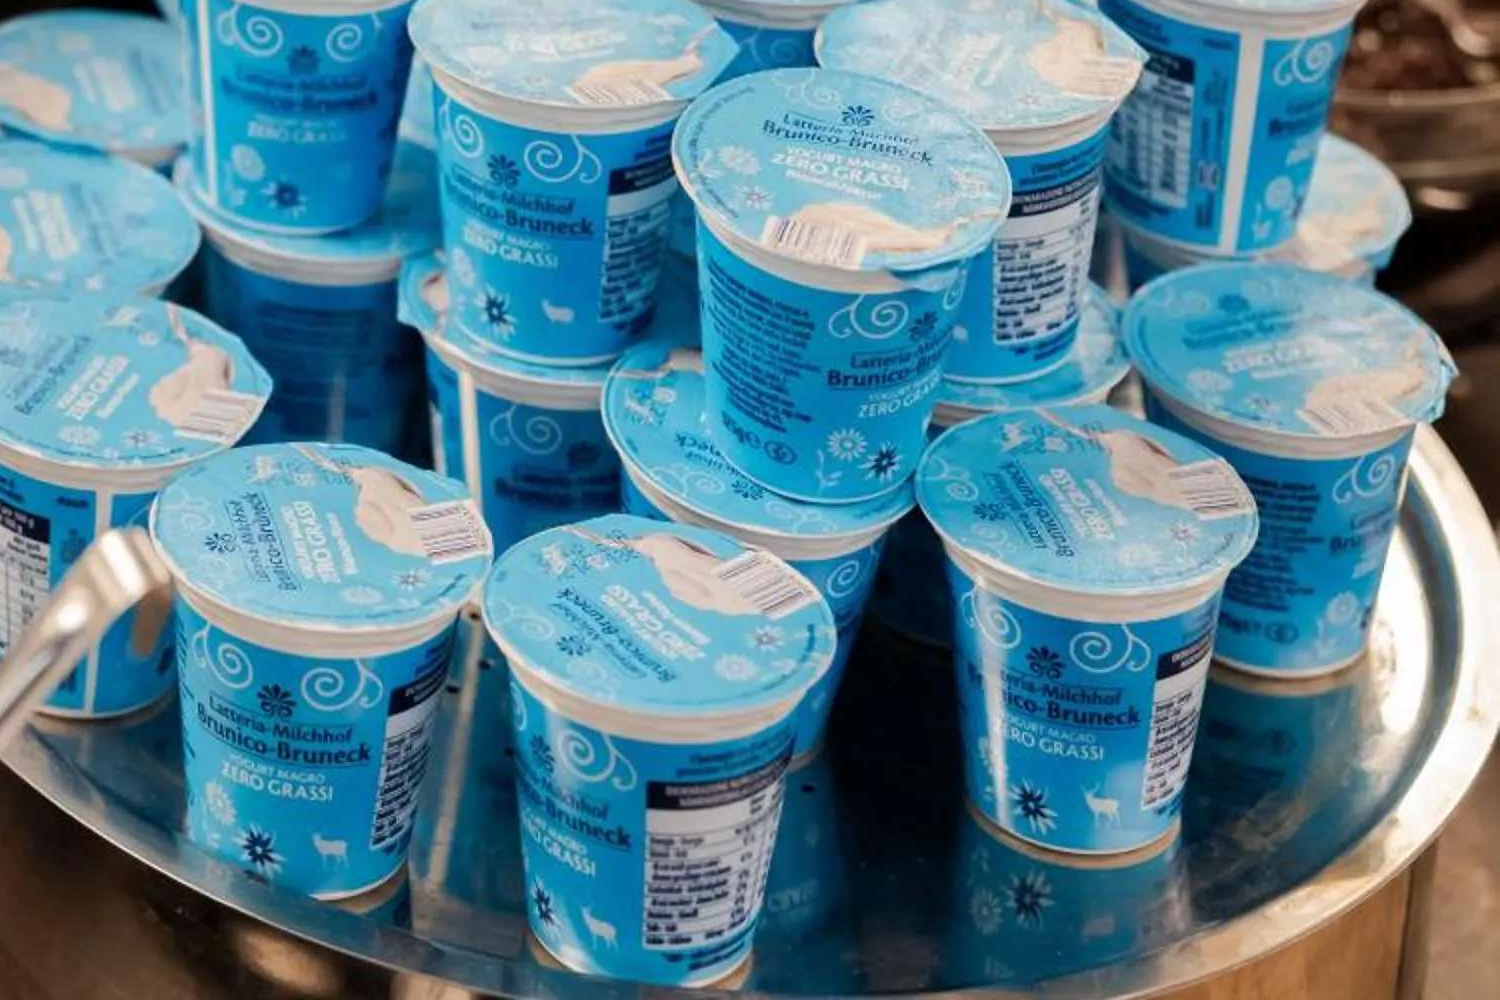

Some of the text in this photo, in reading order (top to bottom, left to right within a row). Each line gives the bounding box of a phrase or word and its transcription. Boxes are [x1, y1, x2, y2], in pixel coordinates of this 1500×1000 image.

[771, 153, 828, 175] ZERO
[832, 166, 909, 191] GRASSI
[858, 399, 901, 418] ZERO
[992, 668, 1123, 705] eria-Milchhof
[197, 701, 372, 765] Brunico-Bruneck
[209, 695, 354, 744] Latteria-Milchhof
[1038, 737, 1104, 761] GRASSI
[221, 759, 334, 801] ZERO GRASSI
[277, 767, 326, 785] MAGRO
